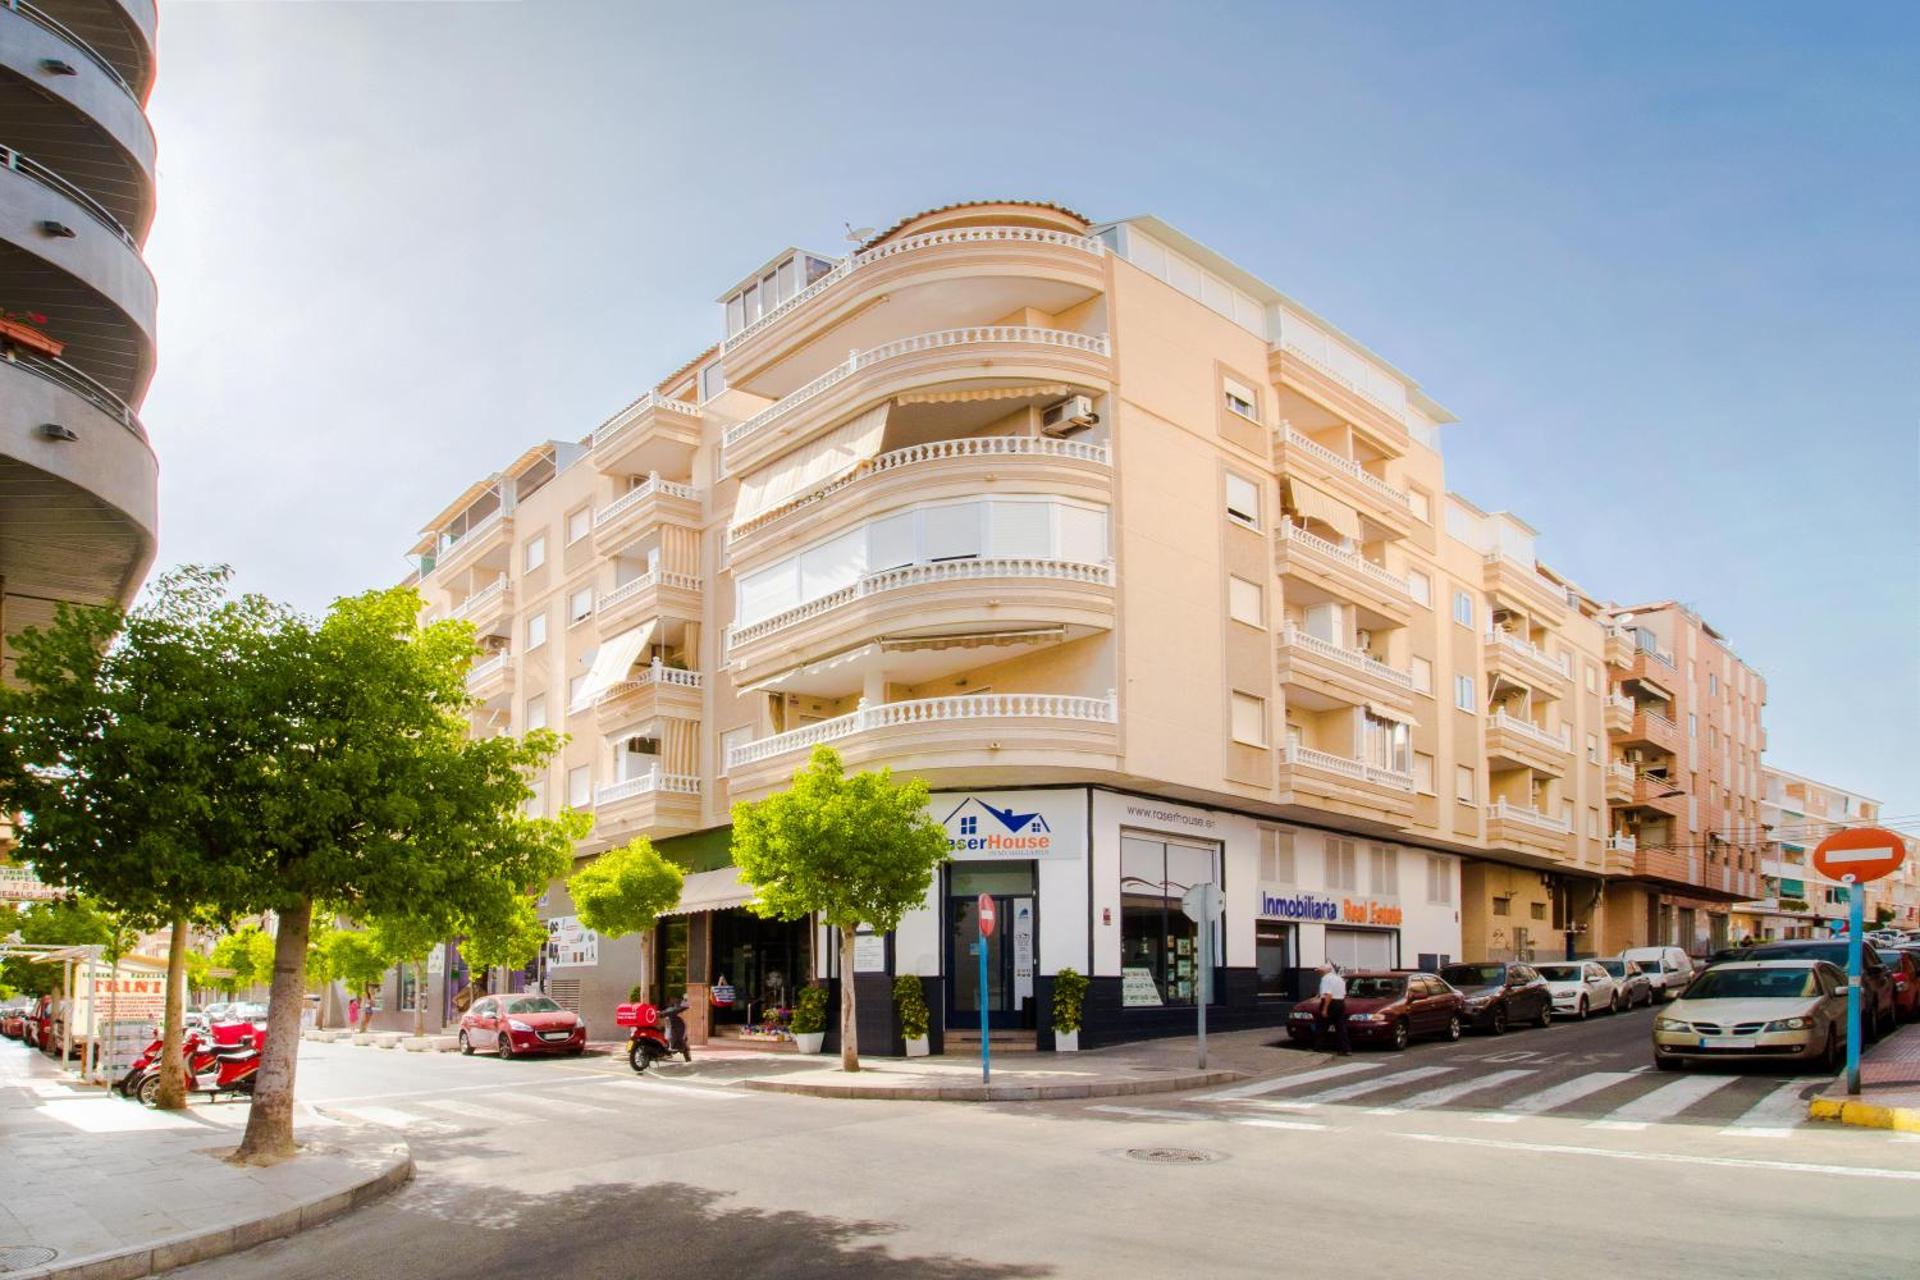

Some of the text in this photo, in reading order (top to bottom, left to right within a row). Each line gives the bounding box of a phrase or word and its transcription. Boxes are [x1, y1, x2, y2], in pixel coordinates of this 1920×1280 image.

[947, 834, 1050, 850] aserHouse
[1262, 891, 1337, 920] Inmobiliaria
[1343, 897, 1367, 923] Real
